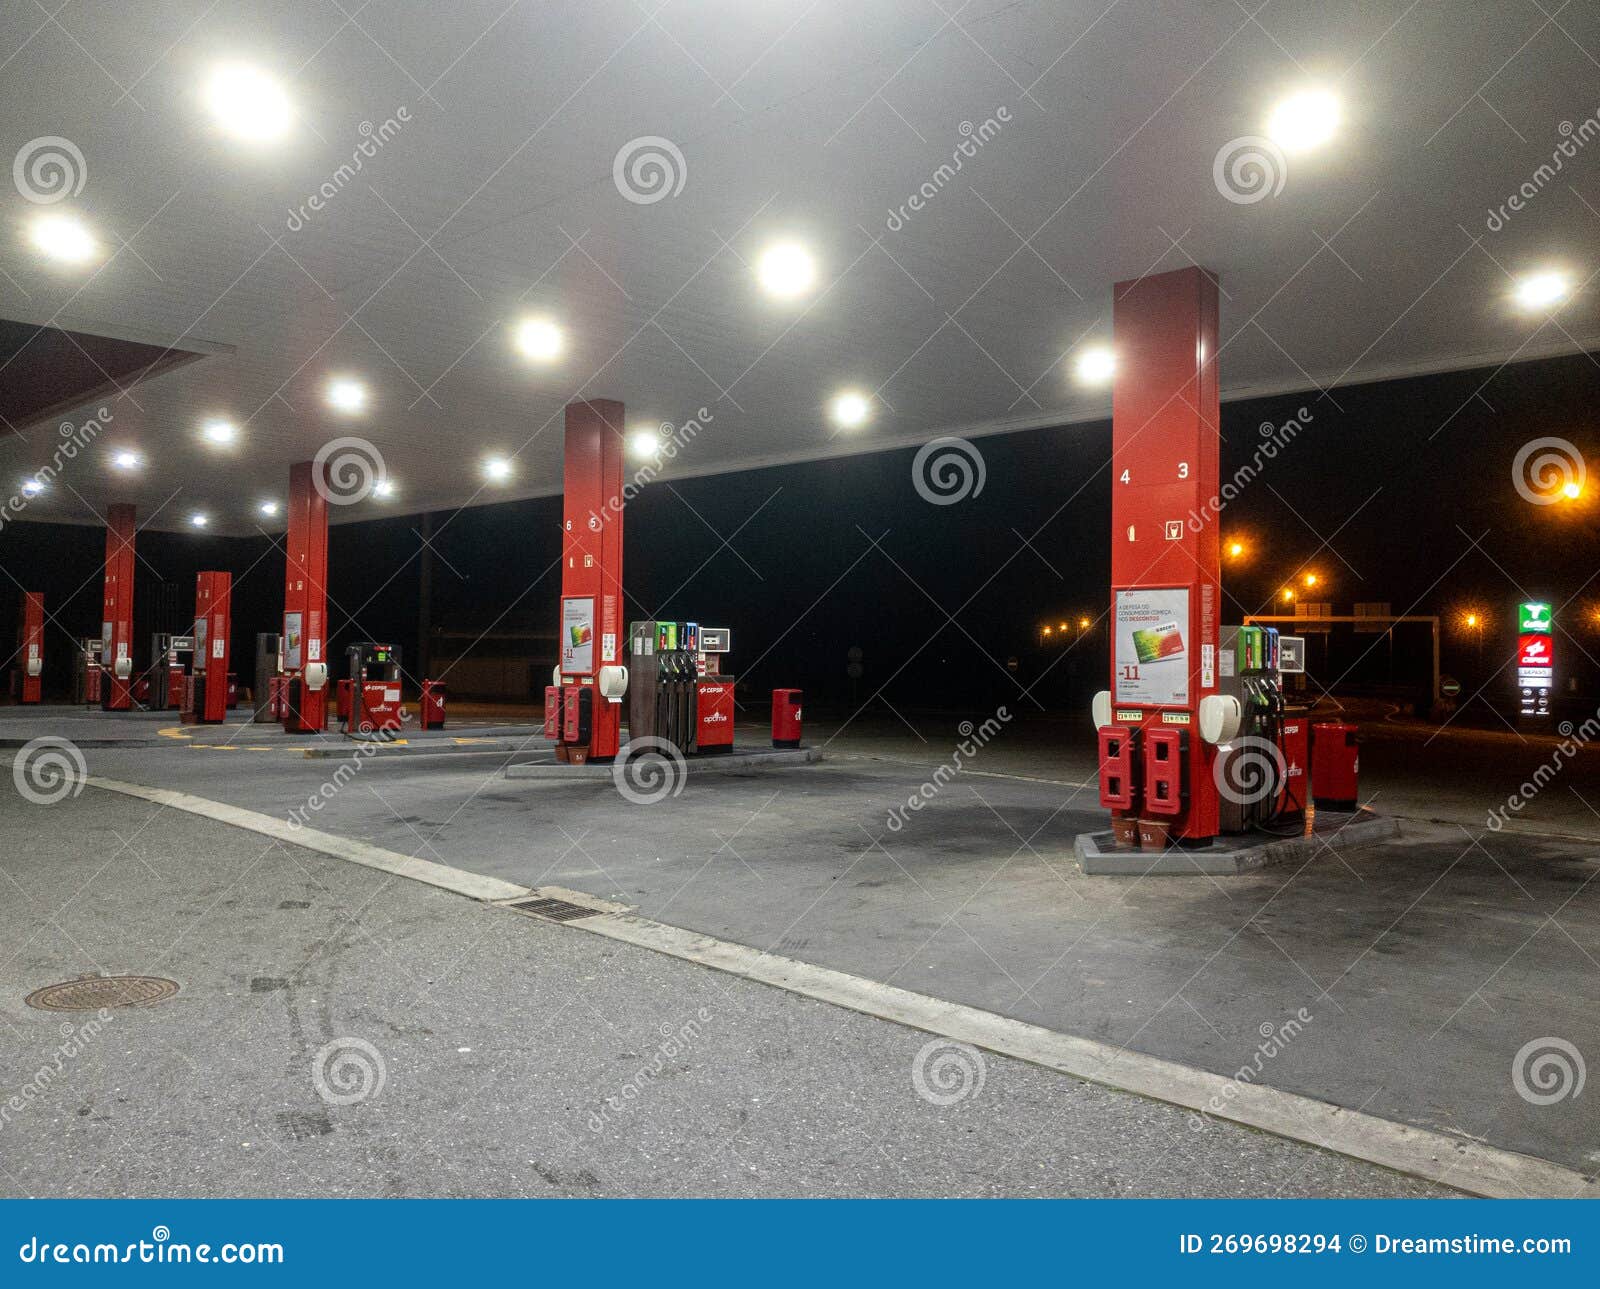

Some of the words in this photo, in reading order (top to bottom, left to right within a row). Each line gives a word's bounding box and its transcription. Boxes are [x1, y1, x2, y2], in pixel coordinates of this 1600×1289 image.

[1120, 469, 1130, 484] 4
[1178, 462, 1188, 479] 3
[566, 520, 572, 531] 6
[704, 712, 727, 724] optima
